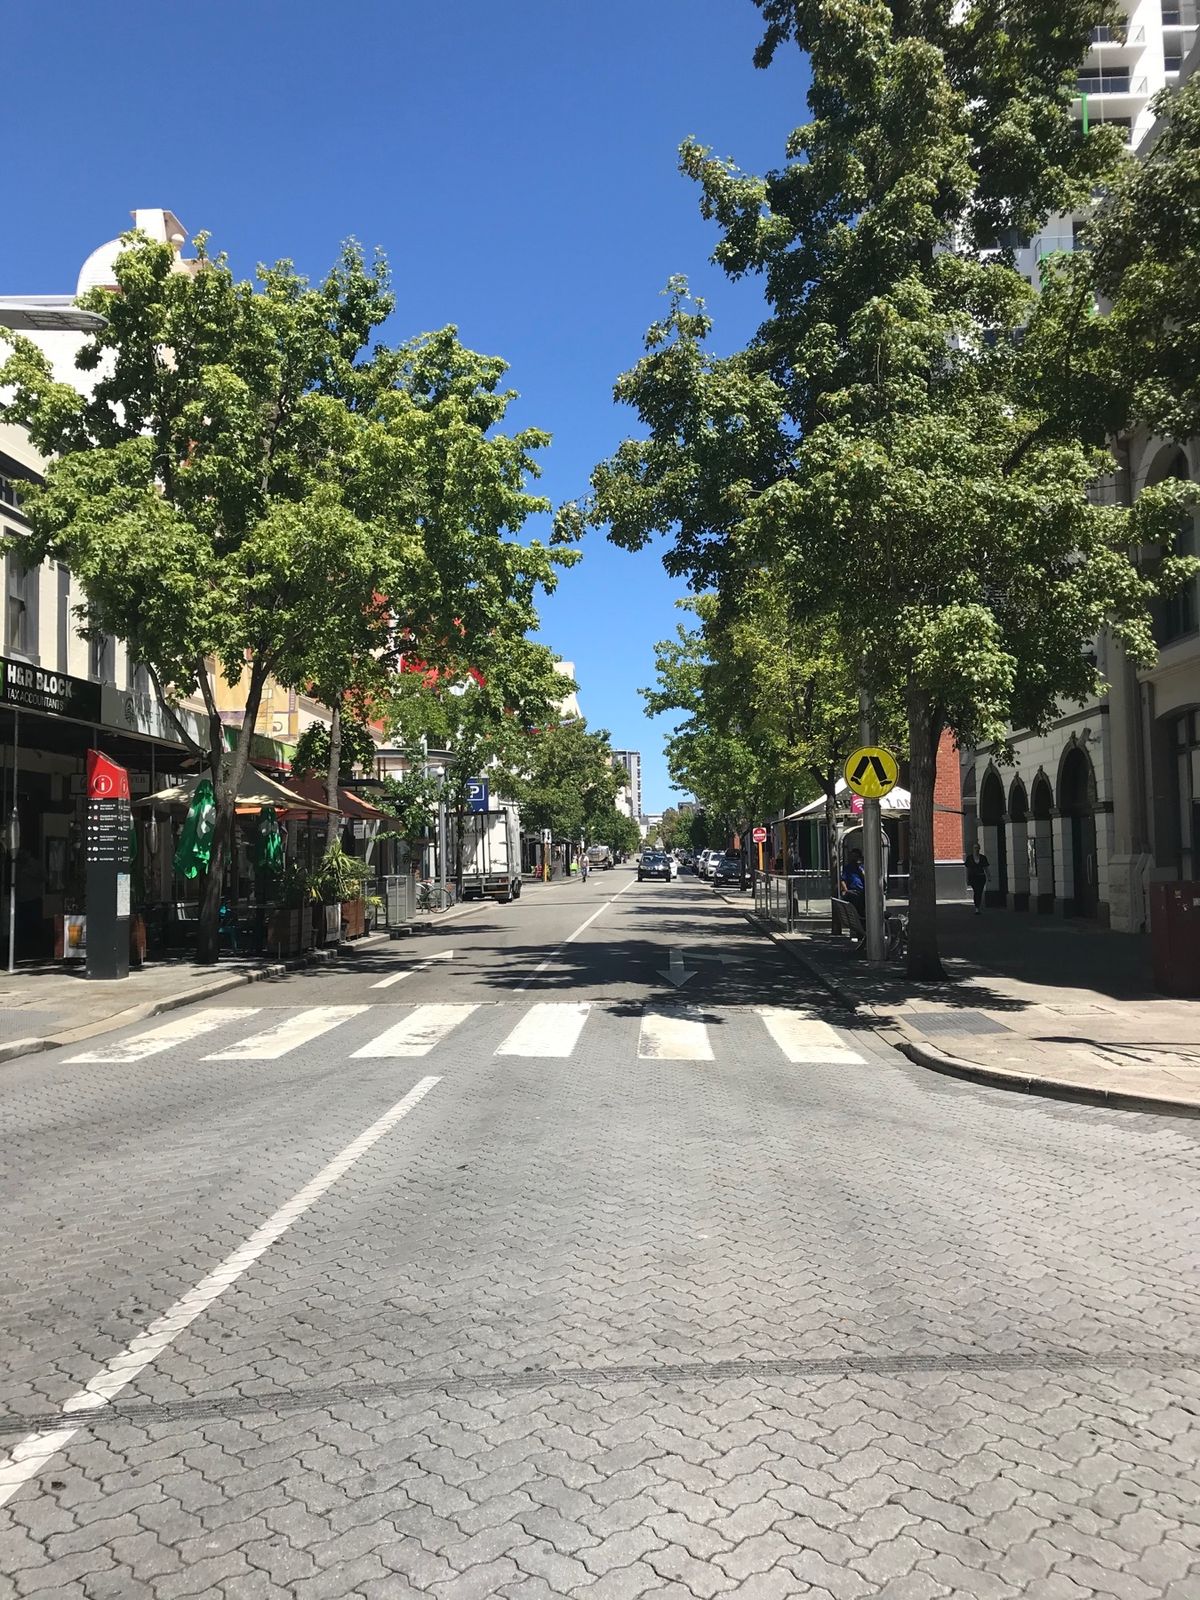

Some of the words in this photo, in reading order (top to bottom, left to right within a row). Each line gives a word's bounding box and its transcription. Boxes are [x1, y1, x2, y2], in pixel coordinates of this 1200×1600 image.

[7, 663, 33, 688] H&R
[36, 671, 73, 698] BLOCK
[7, 687, 20, 700] TAX
[20, 691, 64, 711] ACCOUNTANTS
[470, 785, 480, 798] P
